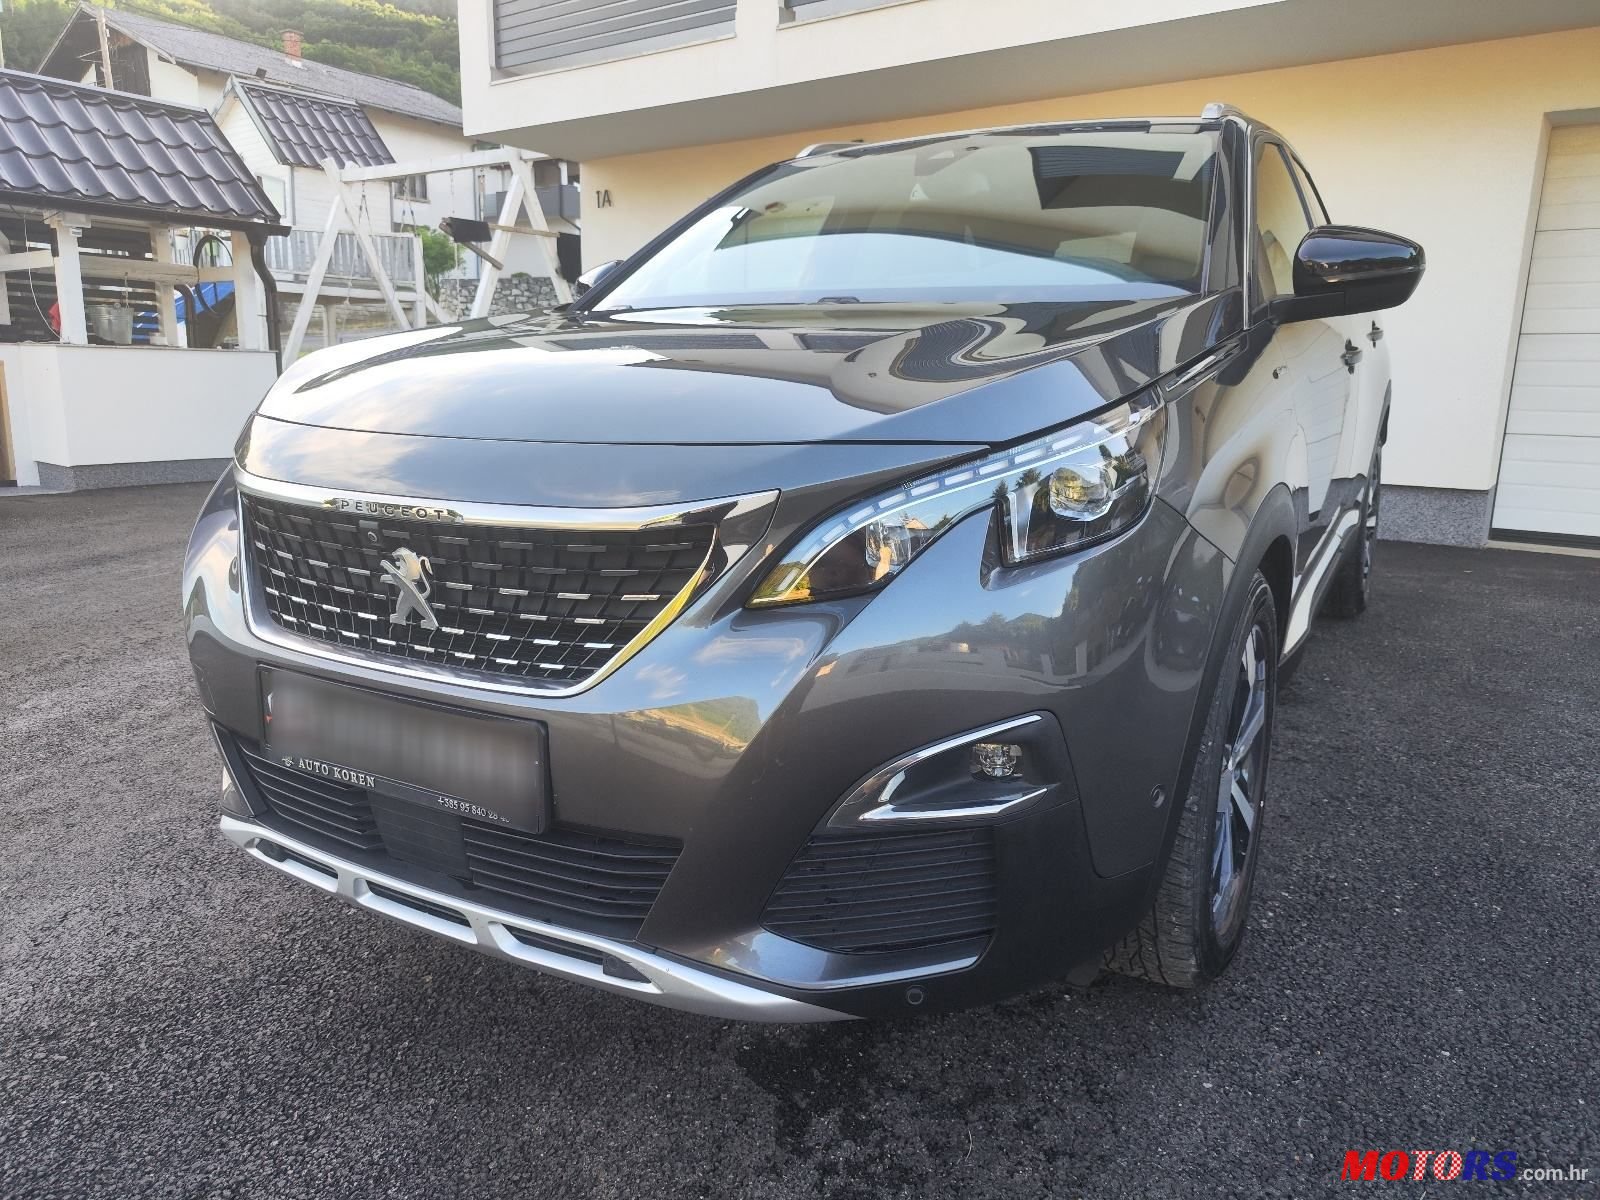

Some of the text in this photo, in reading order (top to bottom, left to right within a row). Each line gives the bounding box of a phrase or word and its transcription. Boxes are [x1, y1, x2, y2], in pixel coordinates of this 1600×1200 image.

[596, 189, 612, 208] 1A
[340, 499, 445, 521] PEUGEOT
[298, 757, 375, 788] AUTO KOREN
[460, 802, 470, 813] 95
[471, 805, 487, 817] 840
